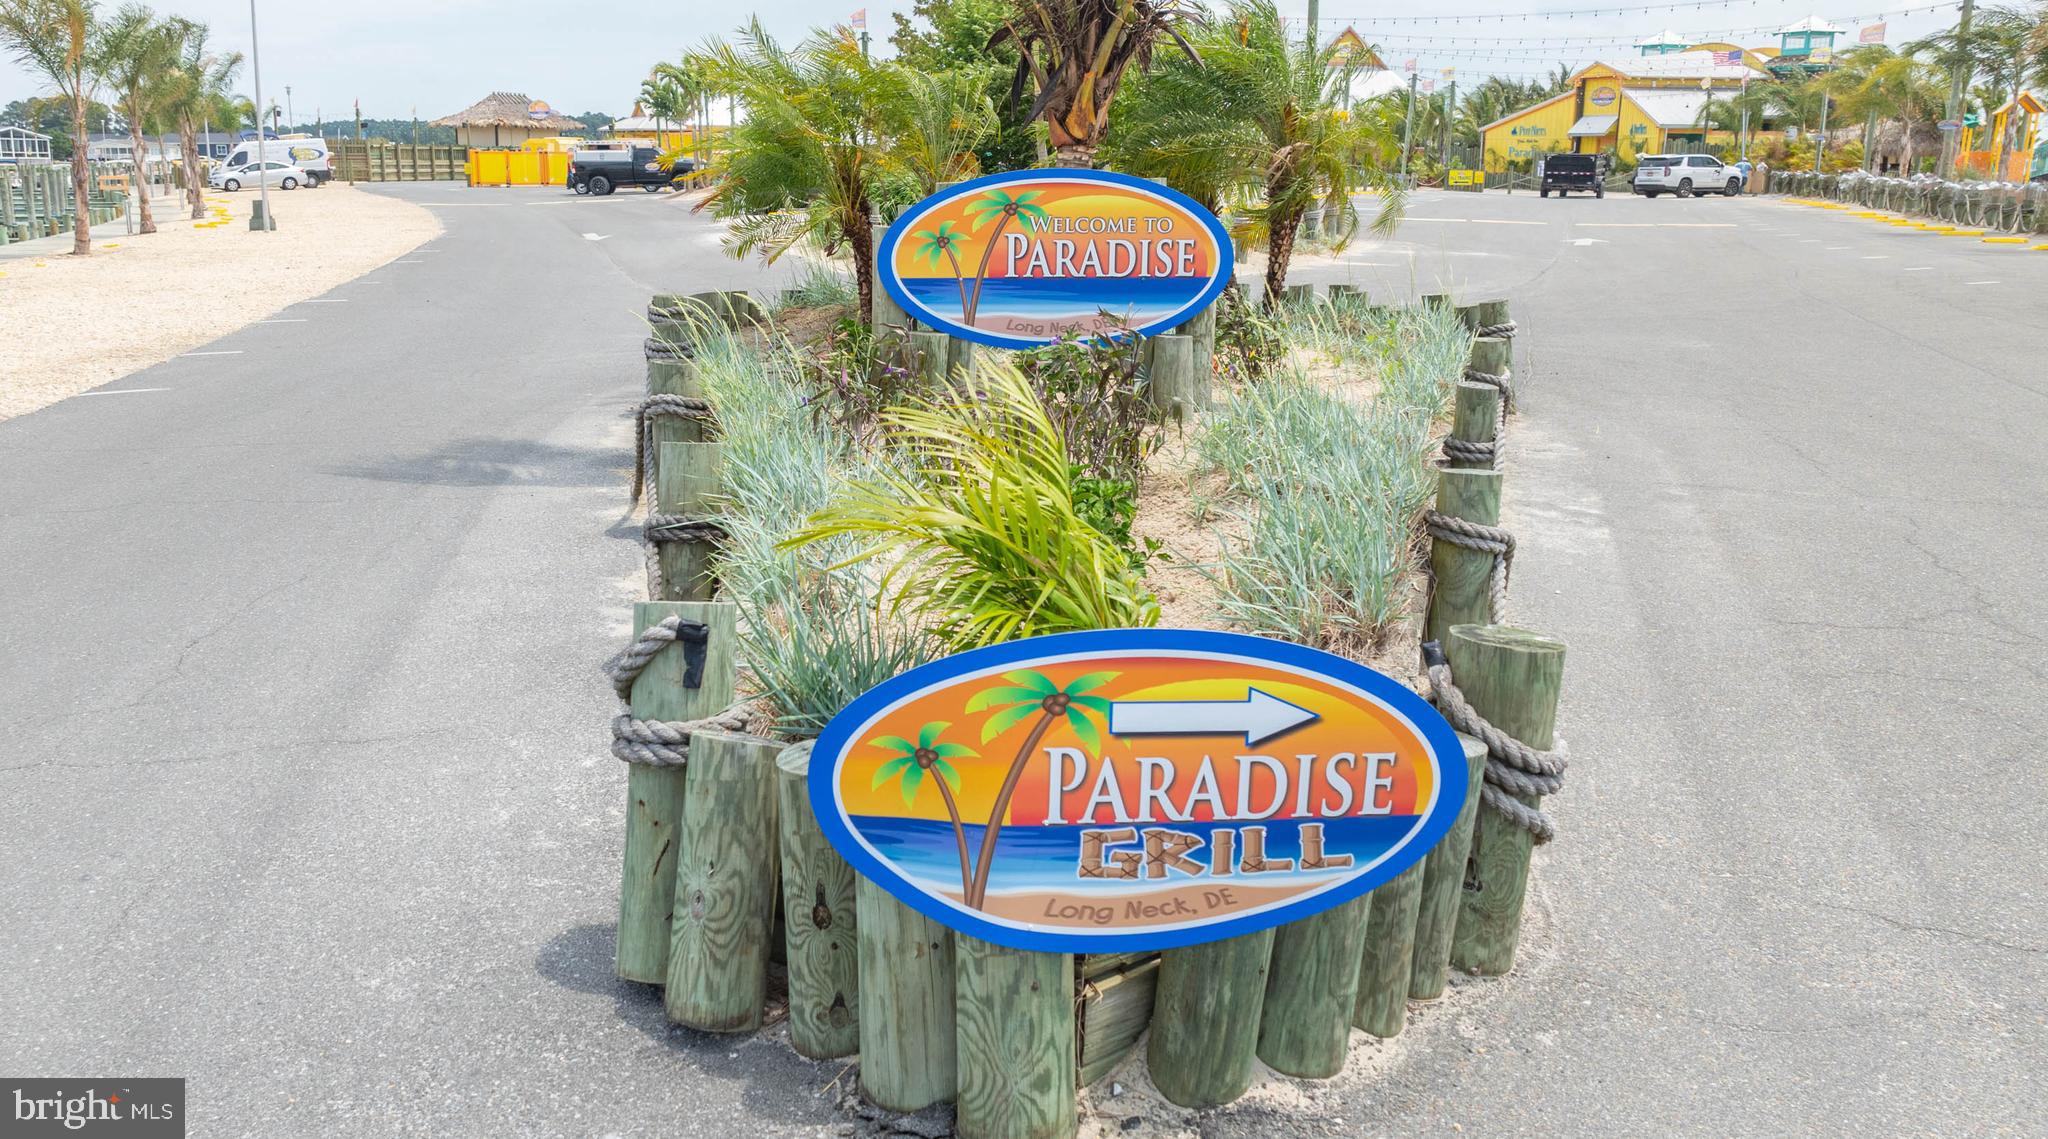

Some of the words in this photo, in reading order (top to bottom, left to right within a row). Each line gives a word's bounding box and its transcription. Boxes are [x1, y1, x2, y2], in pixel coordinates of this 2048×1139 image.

[1029, 215, 1137, 234] WELCOME
[1144, 217, 1174, 234] TO
[1004, 233, 1196, 279] PARADISE
[1006, 319, 1044, 336] Long
[1042, 747, 1397, 824] PARADISE
[1078, 823, 1355, 879] GRILL
[1043, 898, 1114, 925] Long
[1124, 897, 1198, 920] Neck,
[1203, 888, 1238, 909] DE
